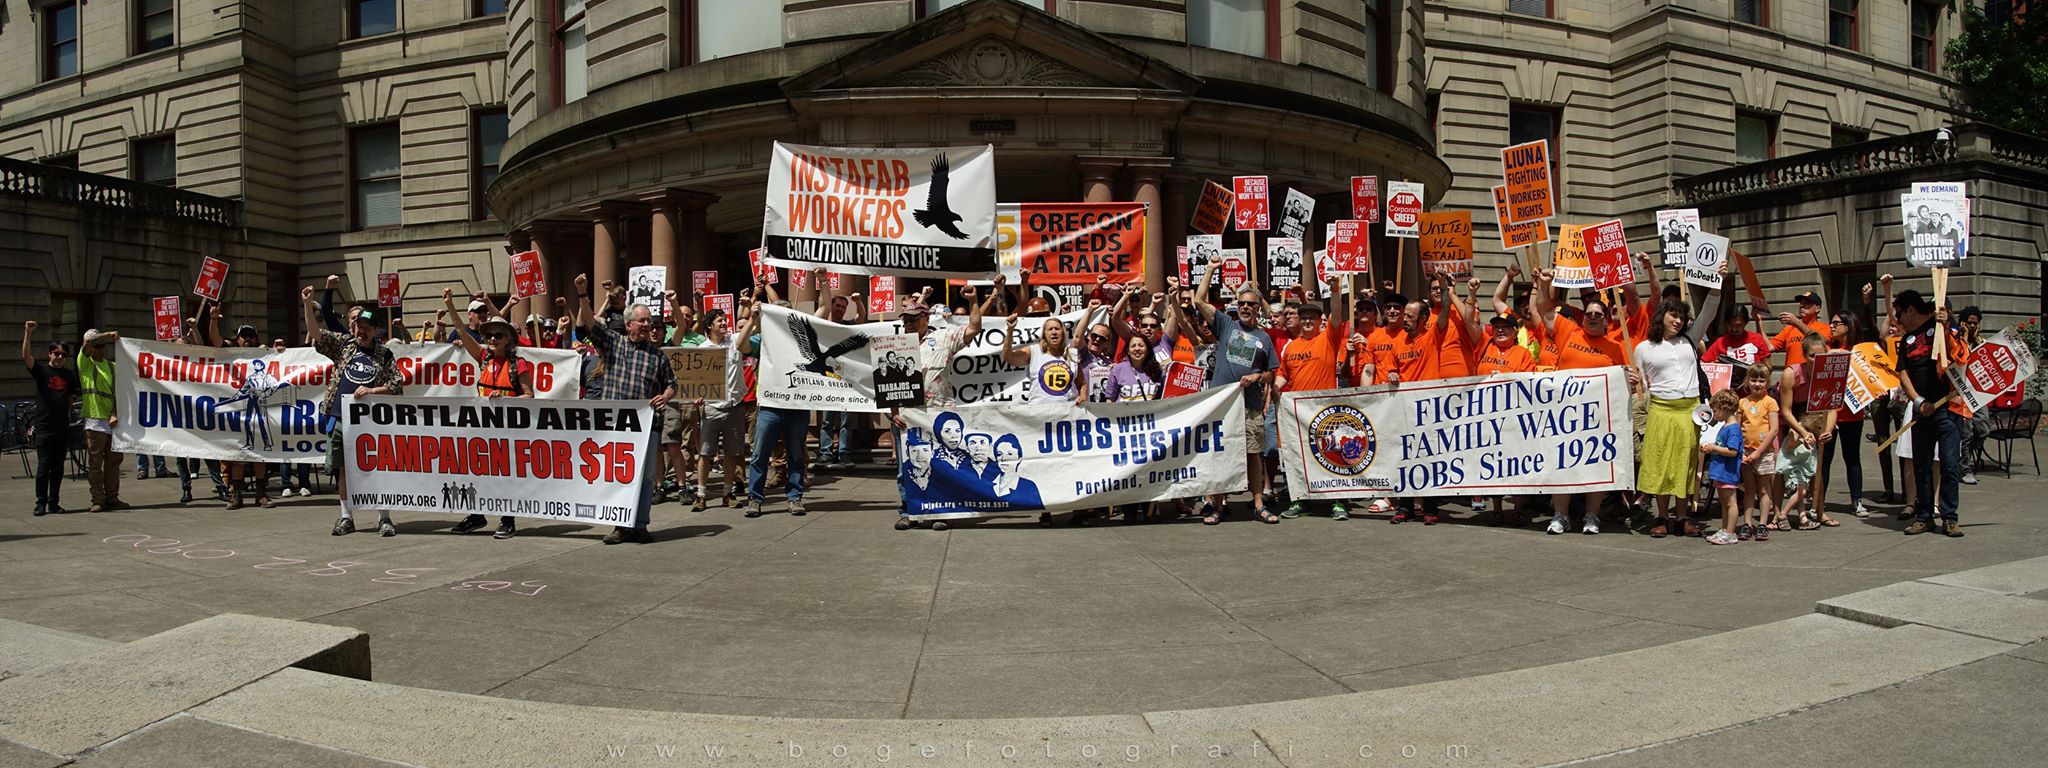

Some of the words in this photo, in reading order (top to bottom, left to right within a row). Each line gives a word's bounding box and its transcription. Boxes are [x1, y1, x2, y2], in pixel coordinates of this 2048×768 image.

[1505, 145, 1544, 169] LIUNA
[790, 153, 910, 197] INSTAFAB
[1507, 166, 1546, 186] FIGHTING
[1920, 185, 1930, 193] WE
[1931, 185, 1958, 193] DEMAND
[1396, 195, 1415, 205] STOP
[1509, 188, 1547, 205] WORKERS'
[788, 194, 906, 240] WORKERS
[1517, 203, 1544, 218] RIGHTS
[1028, 212, 1133, 232] OREGON
[1256, 214, 1267, 222] 15
[1394, 213, 1415, 223] GREED
[1598, 223, 1619, 235] PORQUE
[1041, 233, 1122, 252] NEEDS
[1434, 237, 1460, 249] WE
[1594, 236, 1603, 245] LA
[1603, 231, 1622, 242] RENTA
[1910, 233, 1939, 246] JOBS
[1940, 238, 1955, 246] WITH
[787, 238, 854, 263] COALITION
[857, 243, 882, 266] FOR
[885, 245, 940, 269] JUSTICE
[1593, 245, 1602, 254] NO
[1602, 240, 1625, 251] ESPERA
[1664, 242, 1685, 253] JOBS
[1911, 246, 1955, 260] JUSTICE
[1355, 256, 1366, 265] 15
[1422, 249, 1466, 260] STAND
[1665, 253, 1687, 264] JUST
[1032, 254, 1049, 274] A
[1058, 254, 1131, 273] RAISE
[1225, 260, 1240, 269] STOP
[1270, 266, 1290, 276] JOBS
[1616, 264, 1630, 275] 15
[1225, 277, 1242, 286] GREED
[1270, 276, 1300, 286] JUSTICE
[1686, 269, 1720, 283] McDeath
[534, 280, 543, 288] 15
[1058, 285, 1083, 296] STOP
[1066, 295, 1083, 306] THE
[1733, 349, 1747, 359] 15
[1826, 355, 1849, 364] BECAUSE
[1993, 347, 2016, 372] STOP
[138, 352, 247, 389] Building
[395, 357, 475, 387] Since
[1183, 366, 1202, 375] PORQUE
[1834, 363, 1848, 371] RENT
[1977, 347, 2006, 390] Corporate
[1048, 374, 1067, 388] 15
[1184, 373, 1200, 384] RENTA
[1968, 360, 1994, 391] GREED
[676, 383, 721, 398] NION
[877, 382, 910, 393] TRABAJOS
[1172, 378, 1180, 386] NO
[1180, 380, 1198, 391] ESPERA
[764, 390, 790, 401] Getting
[809, 394, 823, 402] job
[848, 396, 869, 404] since
[885, 390, 914, 401] JUSTICIA
[1831, 393, 1842, 402] 15
[1957, 377, 1967, 391] WITH
[1965, 389, 1979, 409] JUSTICE
[1415, 377, 1554, 427] FIGHTING
[1557, 376, 1591, 403] for
[138, 391, 242, 433] UNION
[350, 403, 531, 429] PORTLAND
[536, 407, 642, 432] AREA
[1310, 407, 1337, 445] LABORERS'
[1340, 406, 1365, 423] LOCAL
[1400, 417, 1505, 461] FAMILY
[1516, 401, 1600, 440] WAGE
[1038, 417, 1113, 453] JOBS
[1116, 414, 1156, 433] WITH
[1113, 420, 1225, 467] JUSTICE
[356, 433, 512, 477] CAMPAIGN
[514, 439, 573, 480] FOR
[579, 438, 635, 485] $15
[1315, 452, 1352, 475] PORTLAND,
[1352, 450, 1374, 473] OREGON
[1393, 457, 1465, 493] JOBS
[1479, 451, 1544, 481] Since
[1555, 433, 1617, 470] 1928
[1075, 475, 1142, 496] Portland,
[1149, 467, 1197, 484] Oregon
[1310, 479, 1350, 489] MUNICIPAL
[1352, 478, 1390, 487] EMPLOYEES
[351, 493, 437, 508] WWW.JWJPDX.ORG
[479, 497, 540, 515] PORTLAND
[542, 501, 571, 517] JOBS
[576, 505, 596, 517] WITH
[921, 501, 956, 511] jwjpdx.org
